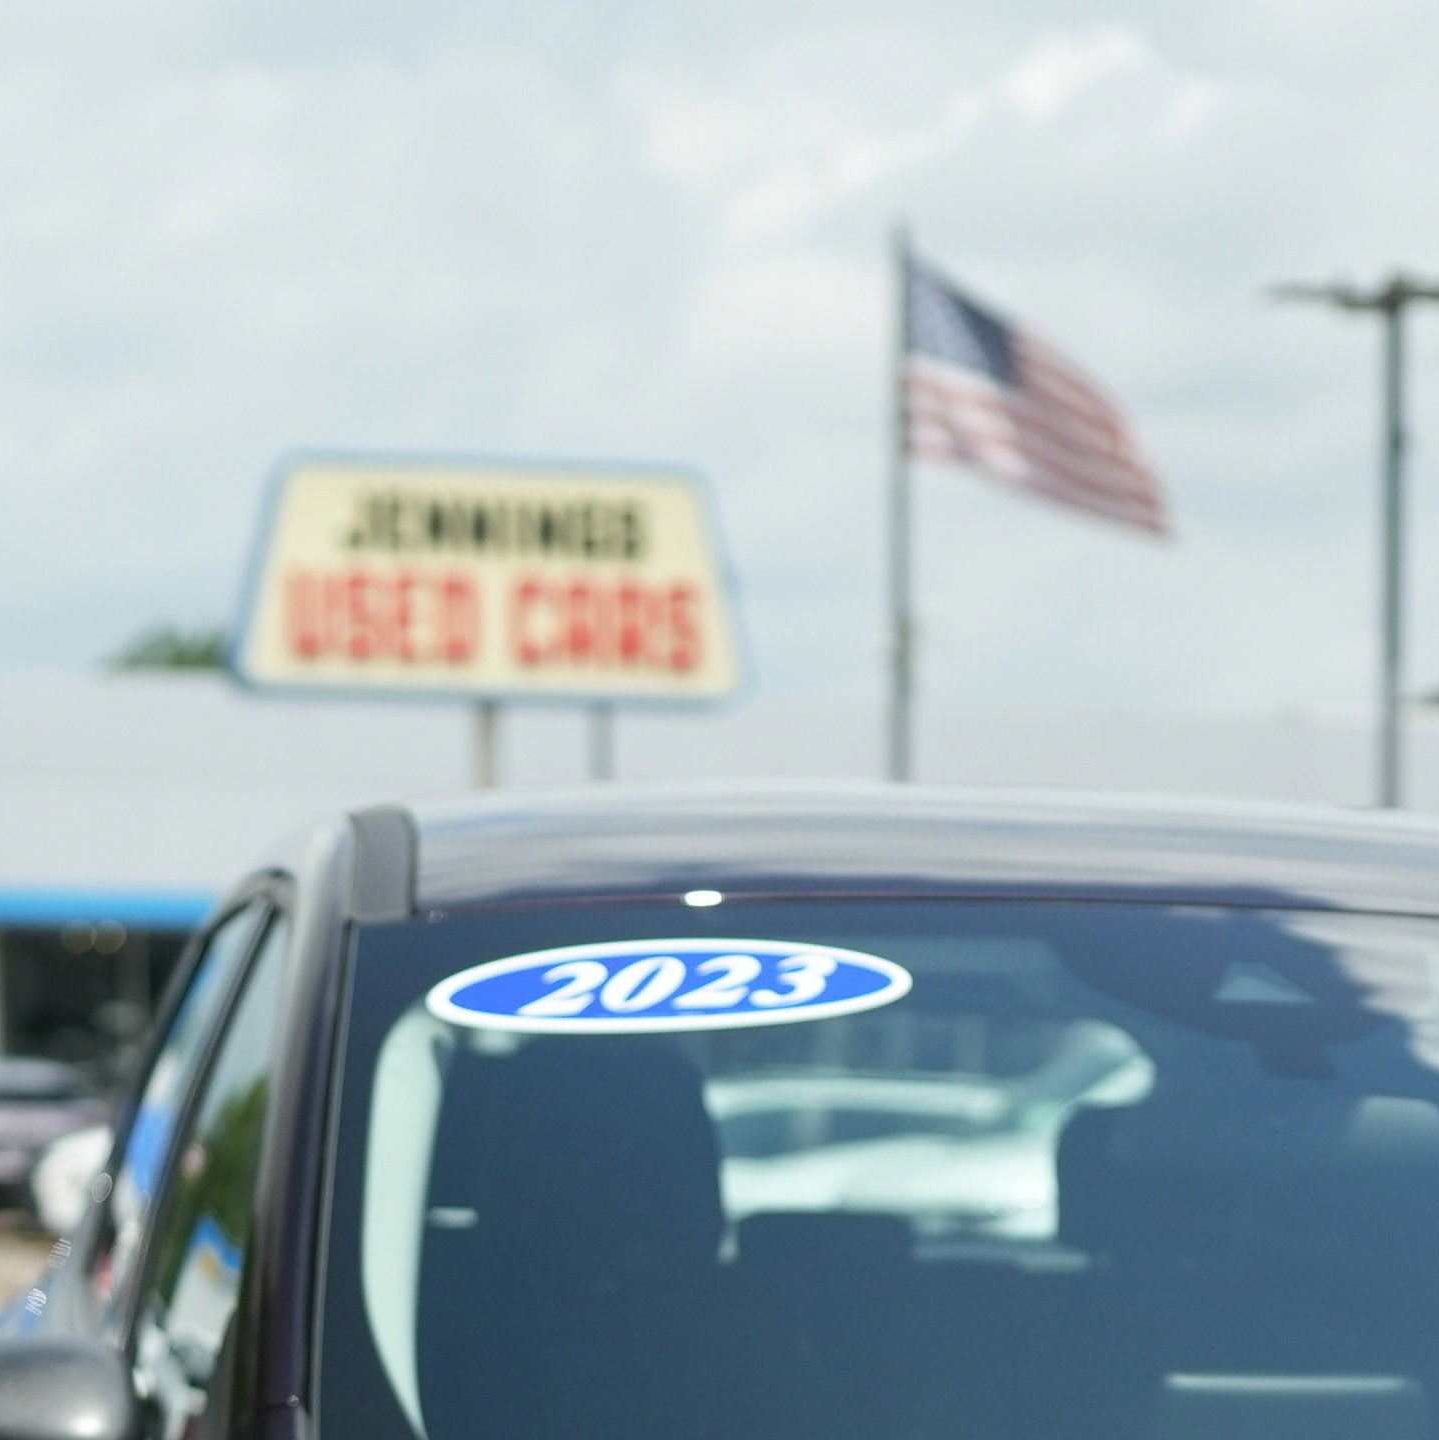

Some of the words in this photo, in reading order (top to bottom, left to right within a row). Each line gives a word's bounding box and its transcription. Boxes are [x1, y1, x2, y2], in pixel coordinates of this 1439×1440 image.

[341, 496, 647, 557] JENNINGS
[283, 574, 480, 664] USED
[510, 580, 703, 672] CARS
[516, 954, 838, 1017] 2023
